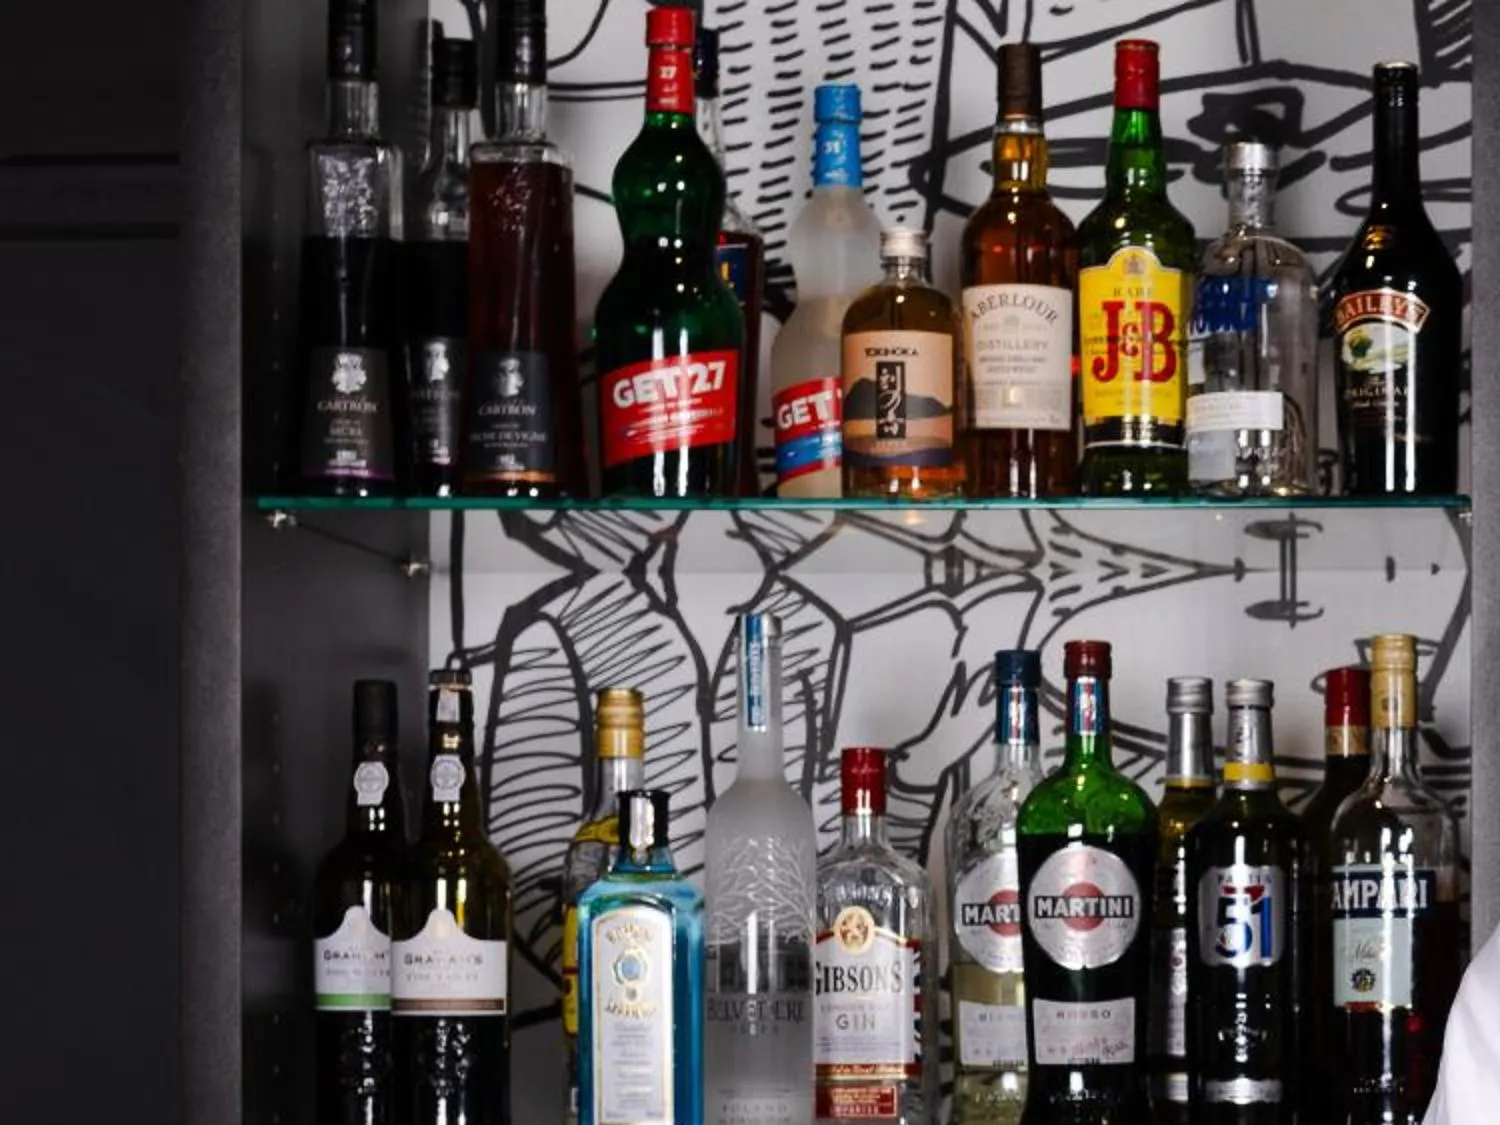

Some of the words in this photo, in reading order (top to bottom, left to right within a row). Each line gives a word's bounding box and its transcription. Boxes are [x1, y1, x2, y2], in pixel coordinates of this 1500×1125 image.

[971, 293, 1059, 326] ABERLOUR
[1091, 300, 1178, 383] J&B
[613, 366, 684, 409] GET
[687, 360, 727, 395] 27
[777, 389, 834, 430] GET
[1037, 898, 1131, 918] MARTINI
[1330, 879, 1428, 910] AMPARI
[964, 905, 1021, 924] MART
[1215, 896, 1273, 959] 51
[835, 1013, 875, 1031] GIN
